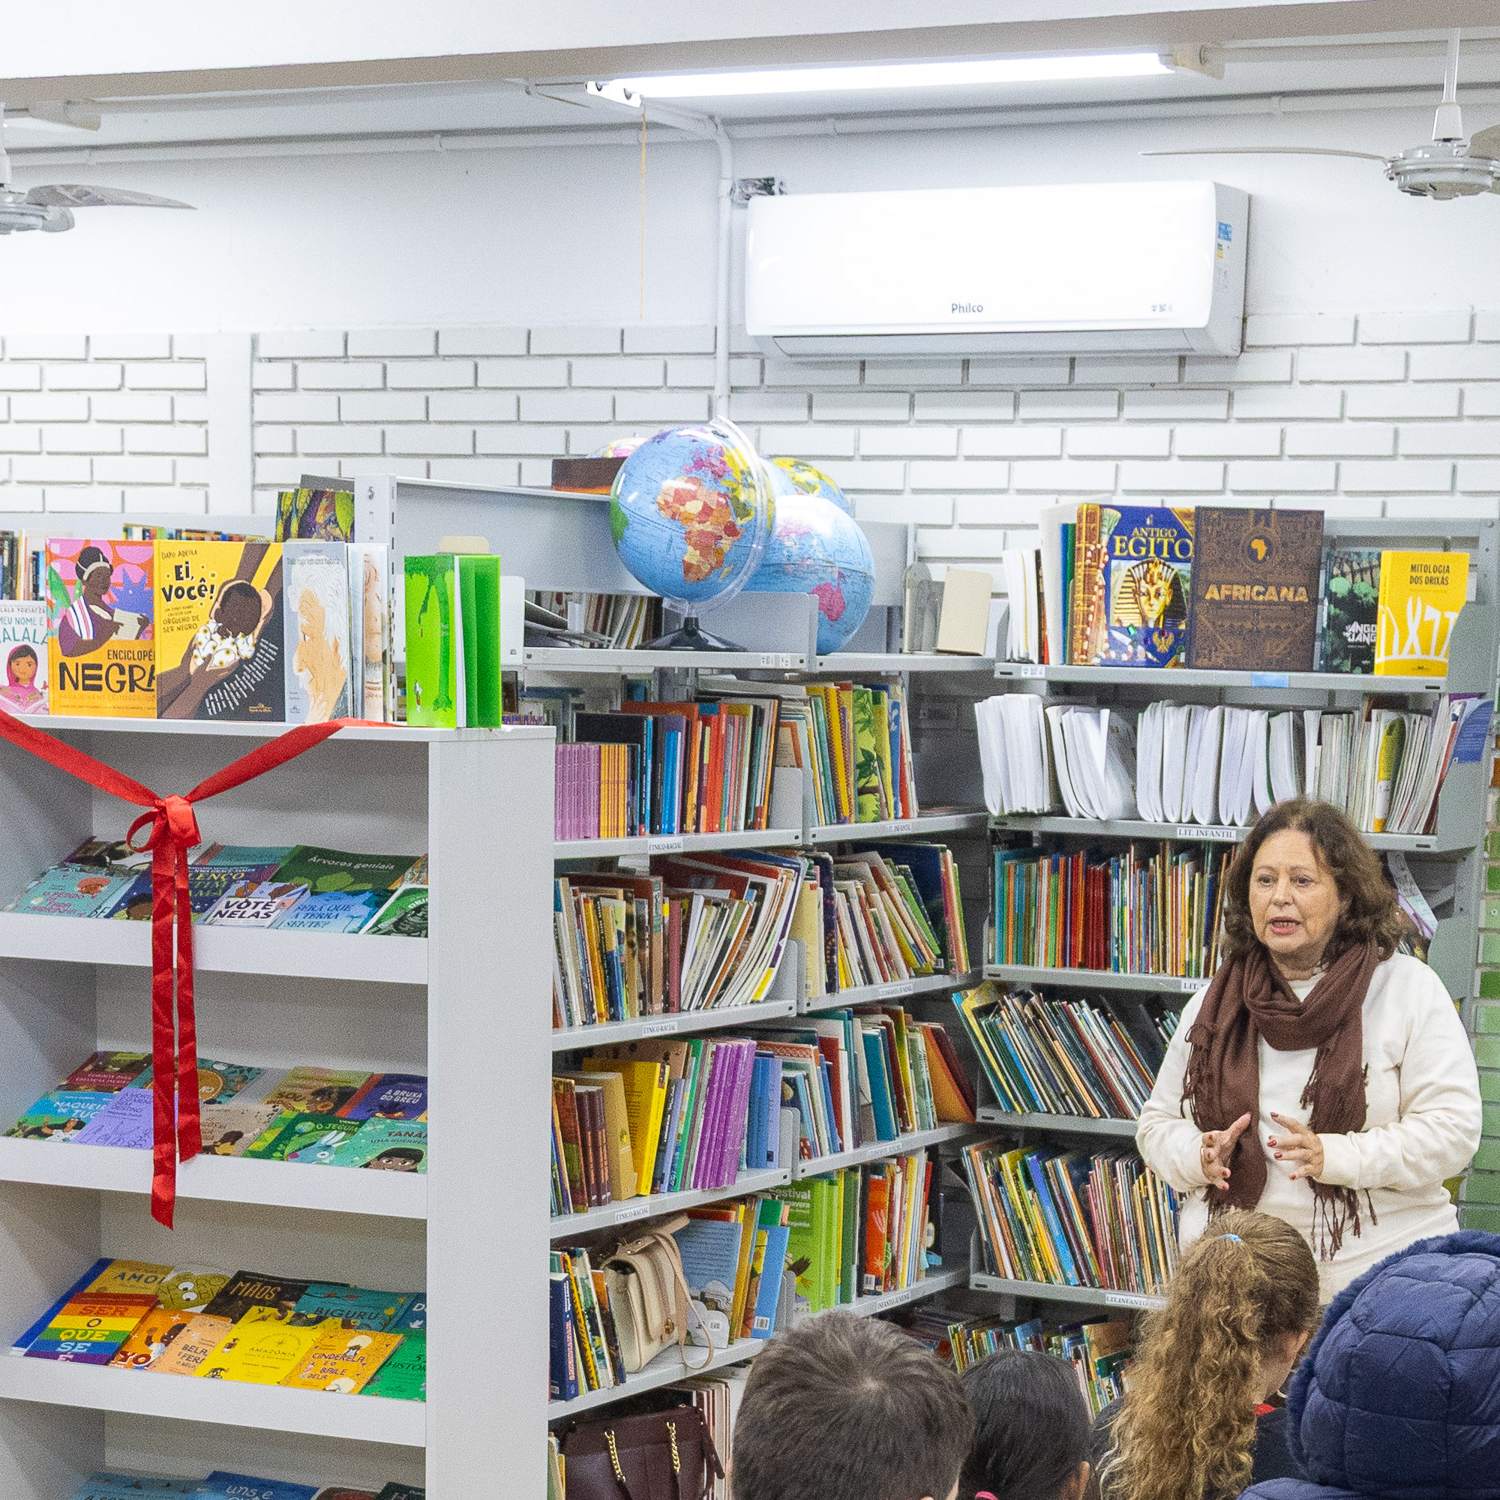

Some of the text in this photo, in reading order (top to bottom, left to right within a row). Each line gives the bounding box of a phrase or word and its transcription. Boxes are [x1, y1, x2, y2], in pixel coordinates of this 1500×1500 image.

[951, 303, 984, 314] Philco
[1131, 527, 1178, 538] ANTIGO
[1113, 535, 1195, 558] EGITO
[1410, 563, 1451, 574] MITOLOGIA
[1409, 575, 1449, 586] DOS ORIXÁS
[1204, 584, 1309, 603] AFRICANA
[14, 616, 37, 626] NOME
[39, 615, 44, 626] É
[107, 649, 156, 662] ENCICLOPÉ
[59, 662, 156, 693] NEGRA
[1178, 828, 1235, 839] LIT. INFANTIL
[307, 855, 395, 871] Árvores geniais
[212, 910, 273, 919] NELAS
[393, 1089, 423, 1099] BRUXA
[230, 1281, 281, 1300] MÃOS
[79, 1305, 128, 1316] SER
[86, 1318, 102, 1328] O
[59, 1330, 110, 1341] QUE
[56, 1342, 90, 1352] SE
[312, 1352, 366, 1363] CINDERELA
[226, 1483, 274, 1500] uns e
